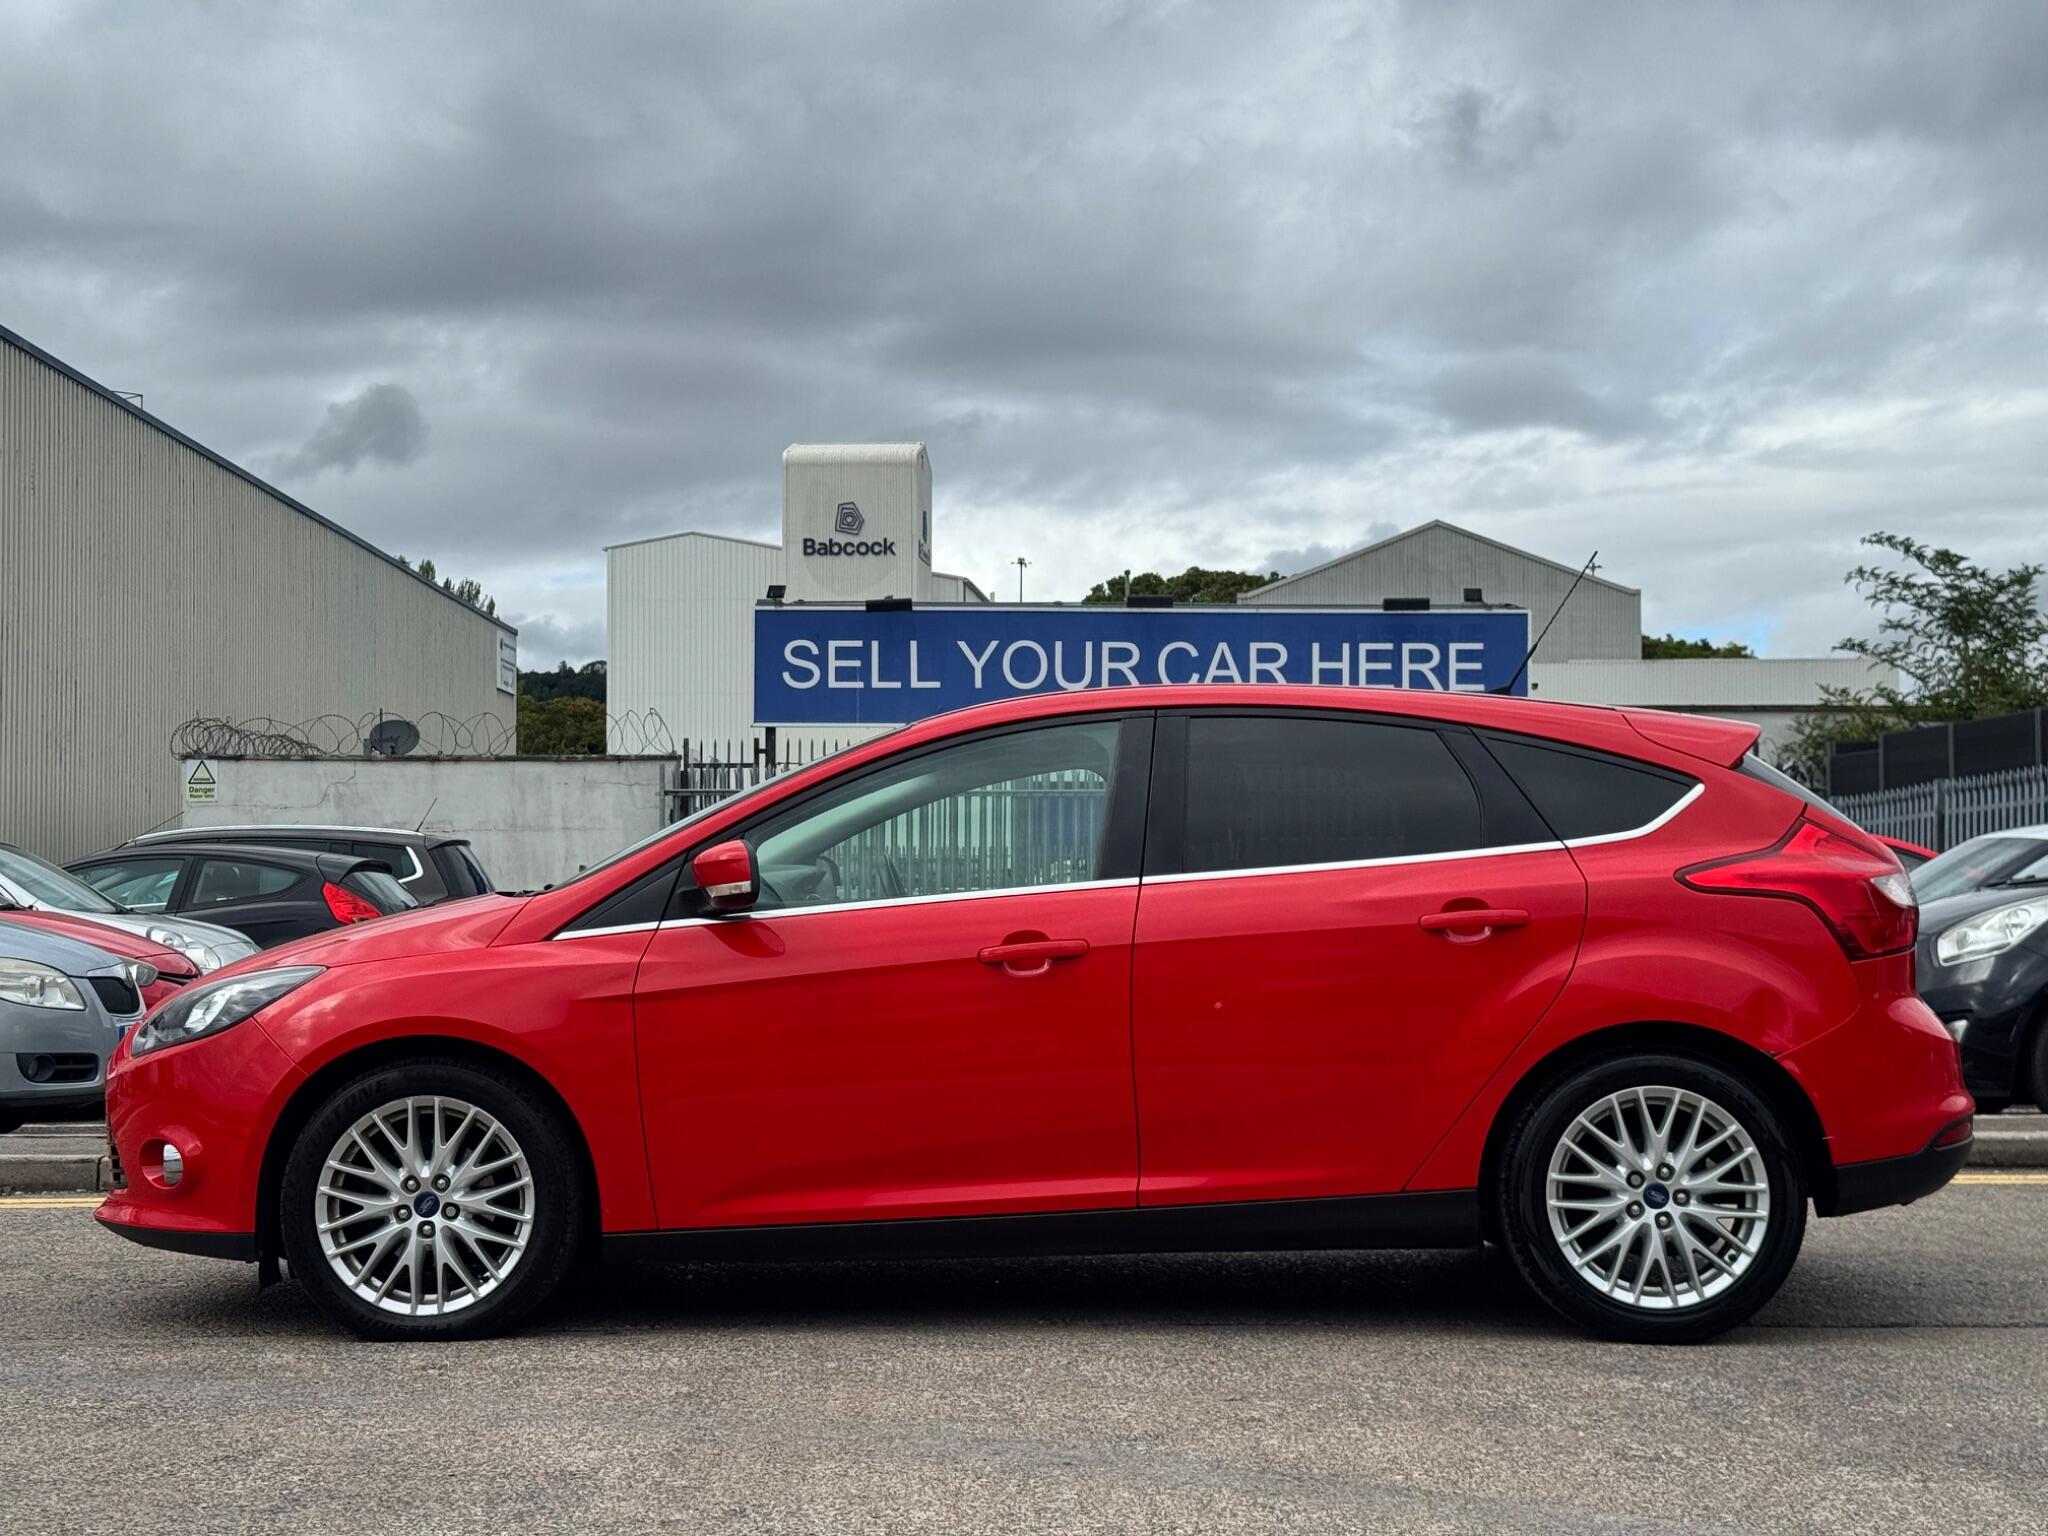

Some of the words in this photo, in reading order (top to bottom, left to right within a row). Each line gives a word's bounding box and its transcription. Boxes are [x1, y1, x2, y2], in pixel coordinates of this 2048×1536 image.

[803, 538, 896, 556] Babcock
[782, 639, 941, 689] SELL
[957, 640, 1141, 690] YOUR
[1157, 641, 1288, 685] CAR
[1312, 642, 1485, 692] HERE
[189, 786, 215, 794] Danger
